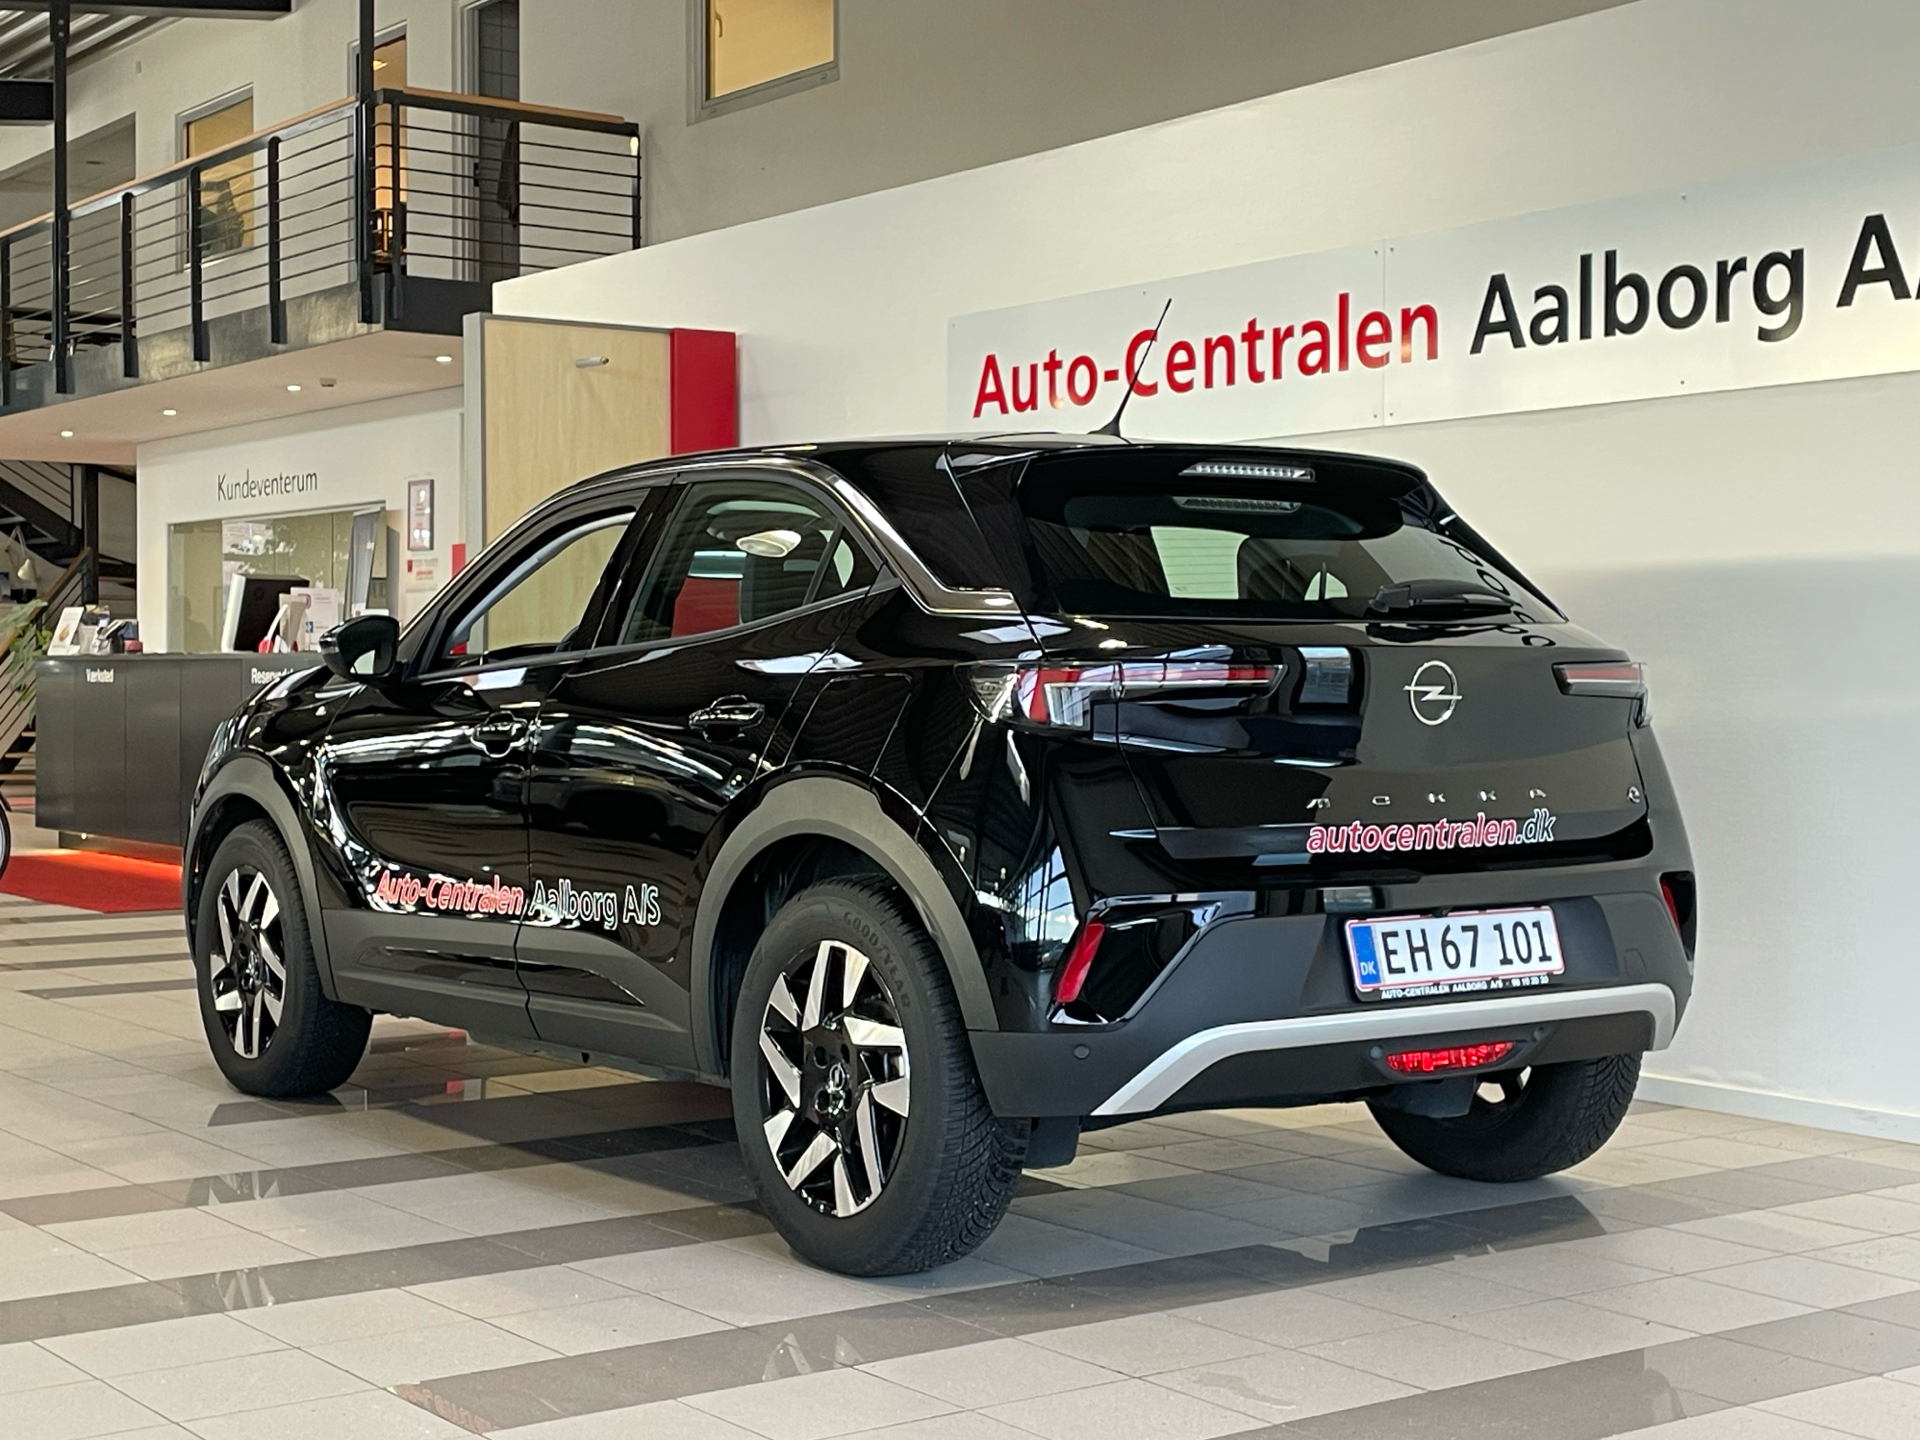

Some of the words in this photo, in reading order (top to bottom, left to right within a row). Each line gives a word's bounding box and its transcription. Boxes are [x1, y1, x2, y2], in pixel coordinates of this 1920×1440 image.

[973, 292, 1438, 419] Auto-Centralen
[1469, 248, 1805, 355] Aalborg
[1836, 213, 1920, 308] A
[217, 468, 318, 501] Kundeventerum
[1306, 809, 1556, 853] autocentralen.dk
[376, 870, 524, 915] Auto-Centralen
[528, 879, 618, 930] Aalborg
[623, 883, 661, 926] A/S
[843, 911, 911, 1008] GOODYEAR
[1360, 961, 1377, 976] DK
[1381, 928, 1433, 974] EH
[1493, 920, 1552, 966] 101
[1381, 983, 1450, 999] AUTO-CENTRALEN
[1452, 981, 1488, 993] AALBORG
